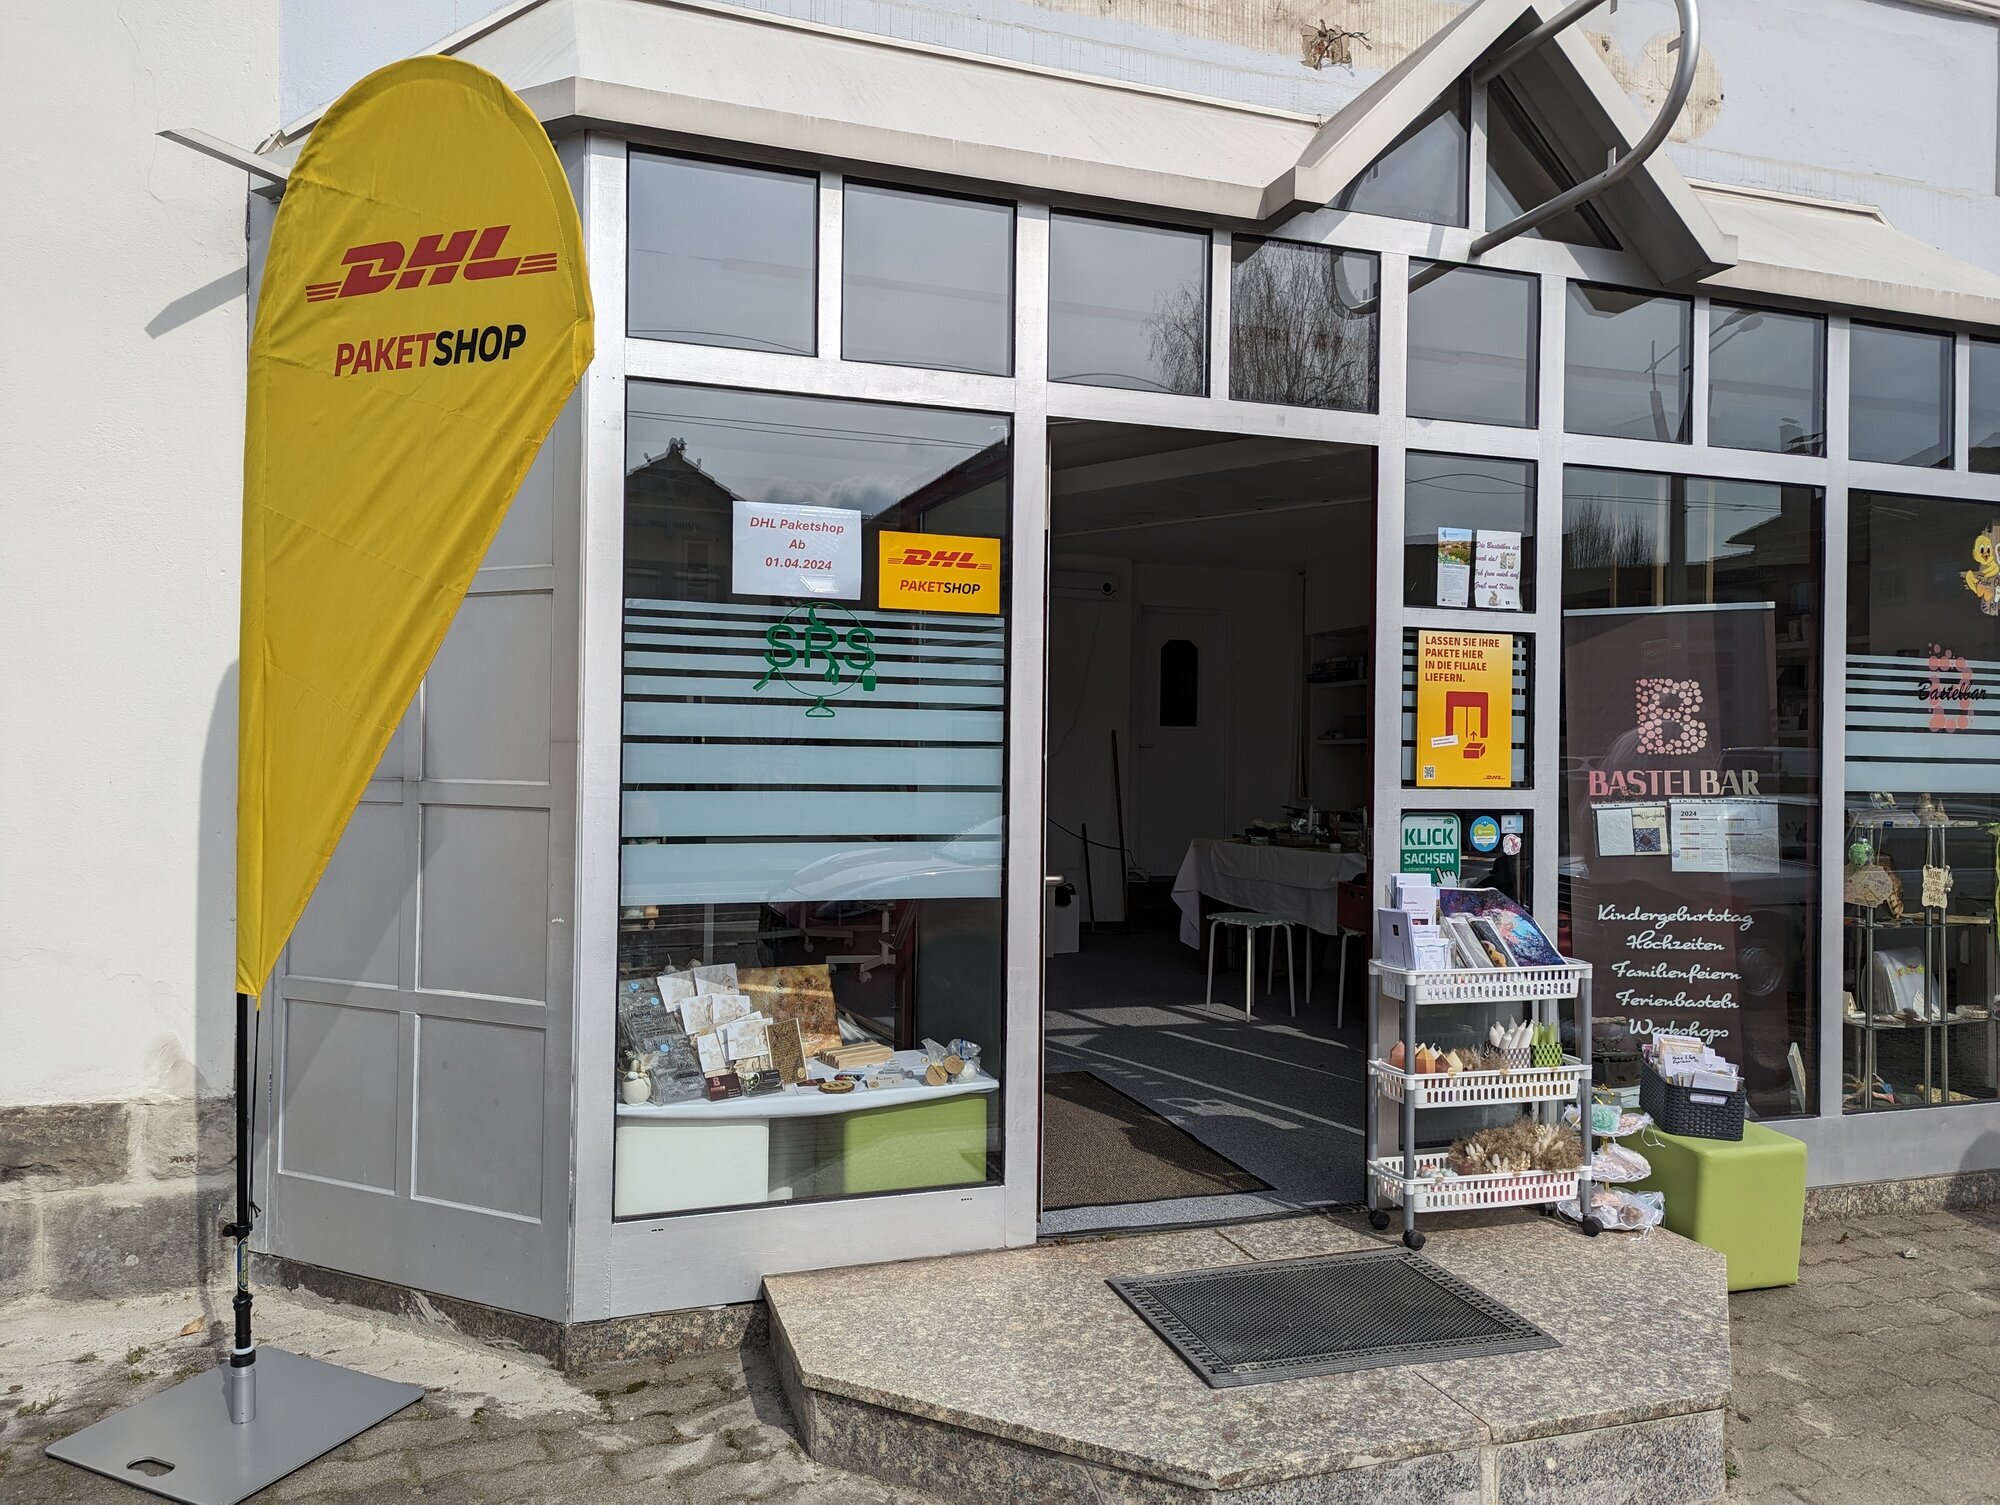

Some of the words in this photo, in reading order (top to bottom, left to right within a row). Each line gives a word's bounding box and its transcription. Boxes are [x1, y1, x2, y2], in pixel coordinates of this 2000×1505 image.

[337, 224, 524, 299] DHL
[333, 324, 527, 378] PAKETSHOP
[749, 516, 776, 530] DHL
[779, 519, 845, 536] Paketshop
[788, 539, 806, 551] Ab
[765, 557, 832, 571] 01.04.2024
[901, 548, 980, 570] DHL
[899, 579, 981, 596] PAKETSHOP
[1425, 635, 1461, 646] LASSEN
[1462, 637, 1477, 647] SIE
[1478, 638, 1500, 648] IHRE
[1425, 648, 1460, 658] PAKETE
[1462, 650, 1484, 659] HIER
[1425, 660, 1435, 670] IN
[1437, 661, 1452, 670] DIE
[1454, 661, 1487, 672] FILIALE
[1425, 672, 1466, 683] LIEFERN.
[1917, 679, 1988, 702] Bastelbar
[1588, 769, 1761, 796] BASTELBAR
[1404, 828, 1454, 846] KLICK
[1403, 853, 1455, 865] SACHSEN
[1597, 904, 1755, 931] Kindergeburtstag
[1626, 930, 1725, 951] Hochzeiten
[1611, 960, 1742, 984] Familienfeiern
[1615, 988, 1740, 1010] Ferienbasteln
[1628, 1018, 1729, 1045] Workshops
